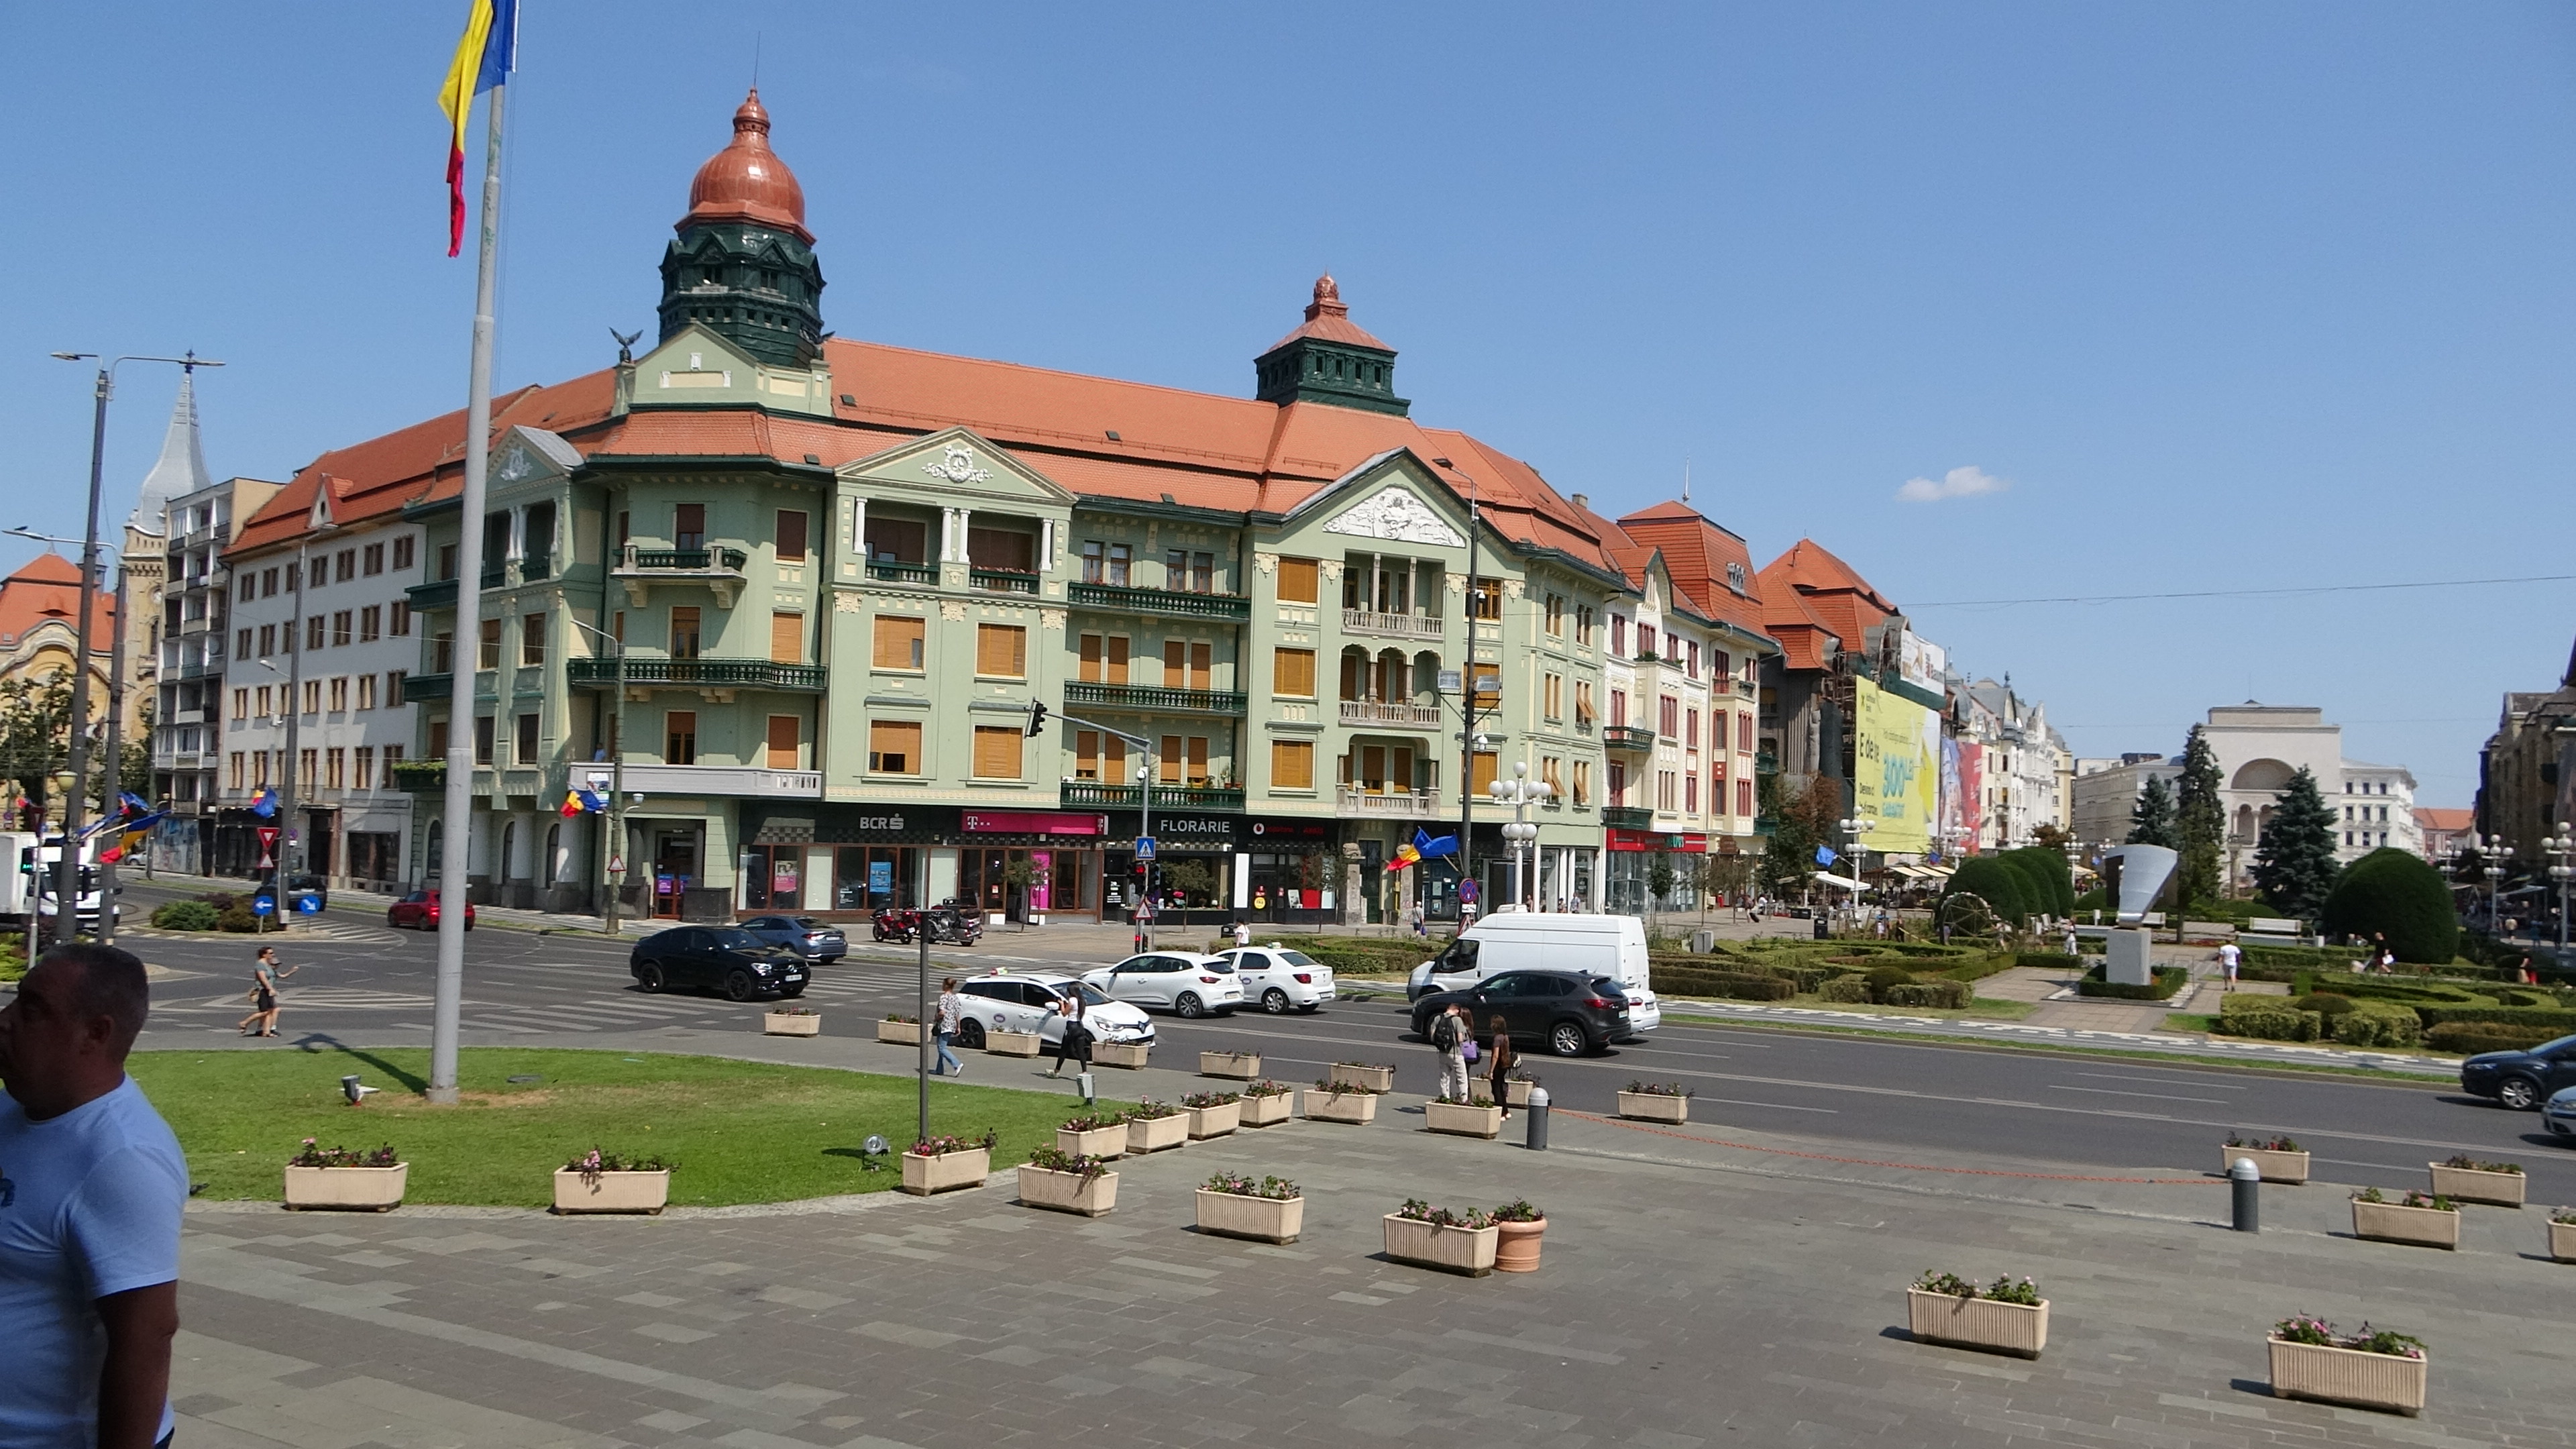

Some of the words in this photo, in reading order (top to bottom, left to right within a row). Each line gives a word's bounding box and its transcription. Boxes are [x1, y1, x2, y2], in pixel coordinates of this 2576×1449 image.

[1860, 733, 1864, 757] E
[1866, 733, 1874, 760] de
[1882, 752, 1905, 798] 300
[860, 816, 888, 830] BCR
[1161, 817, 1230, 833] FLORĂRIE
